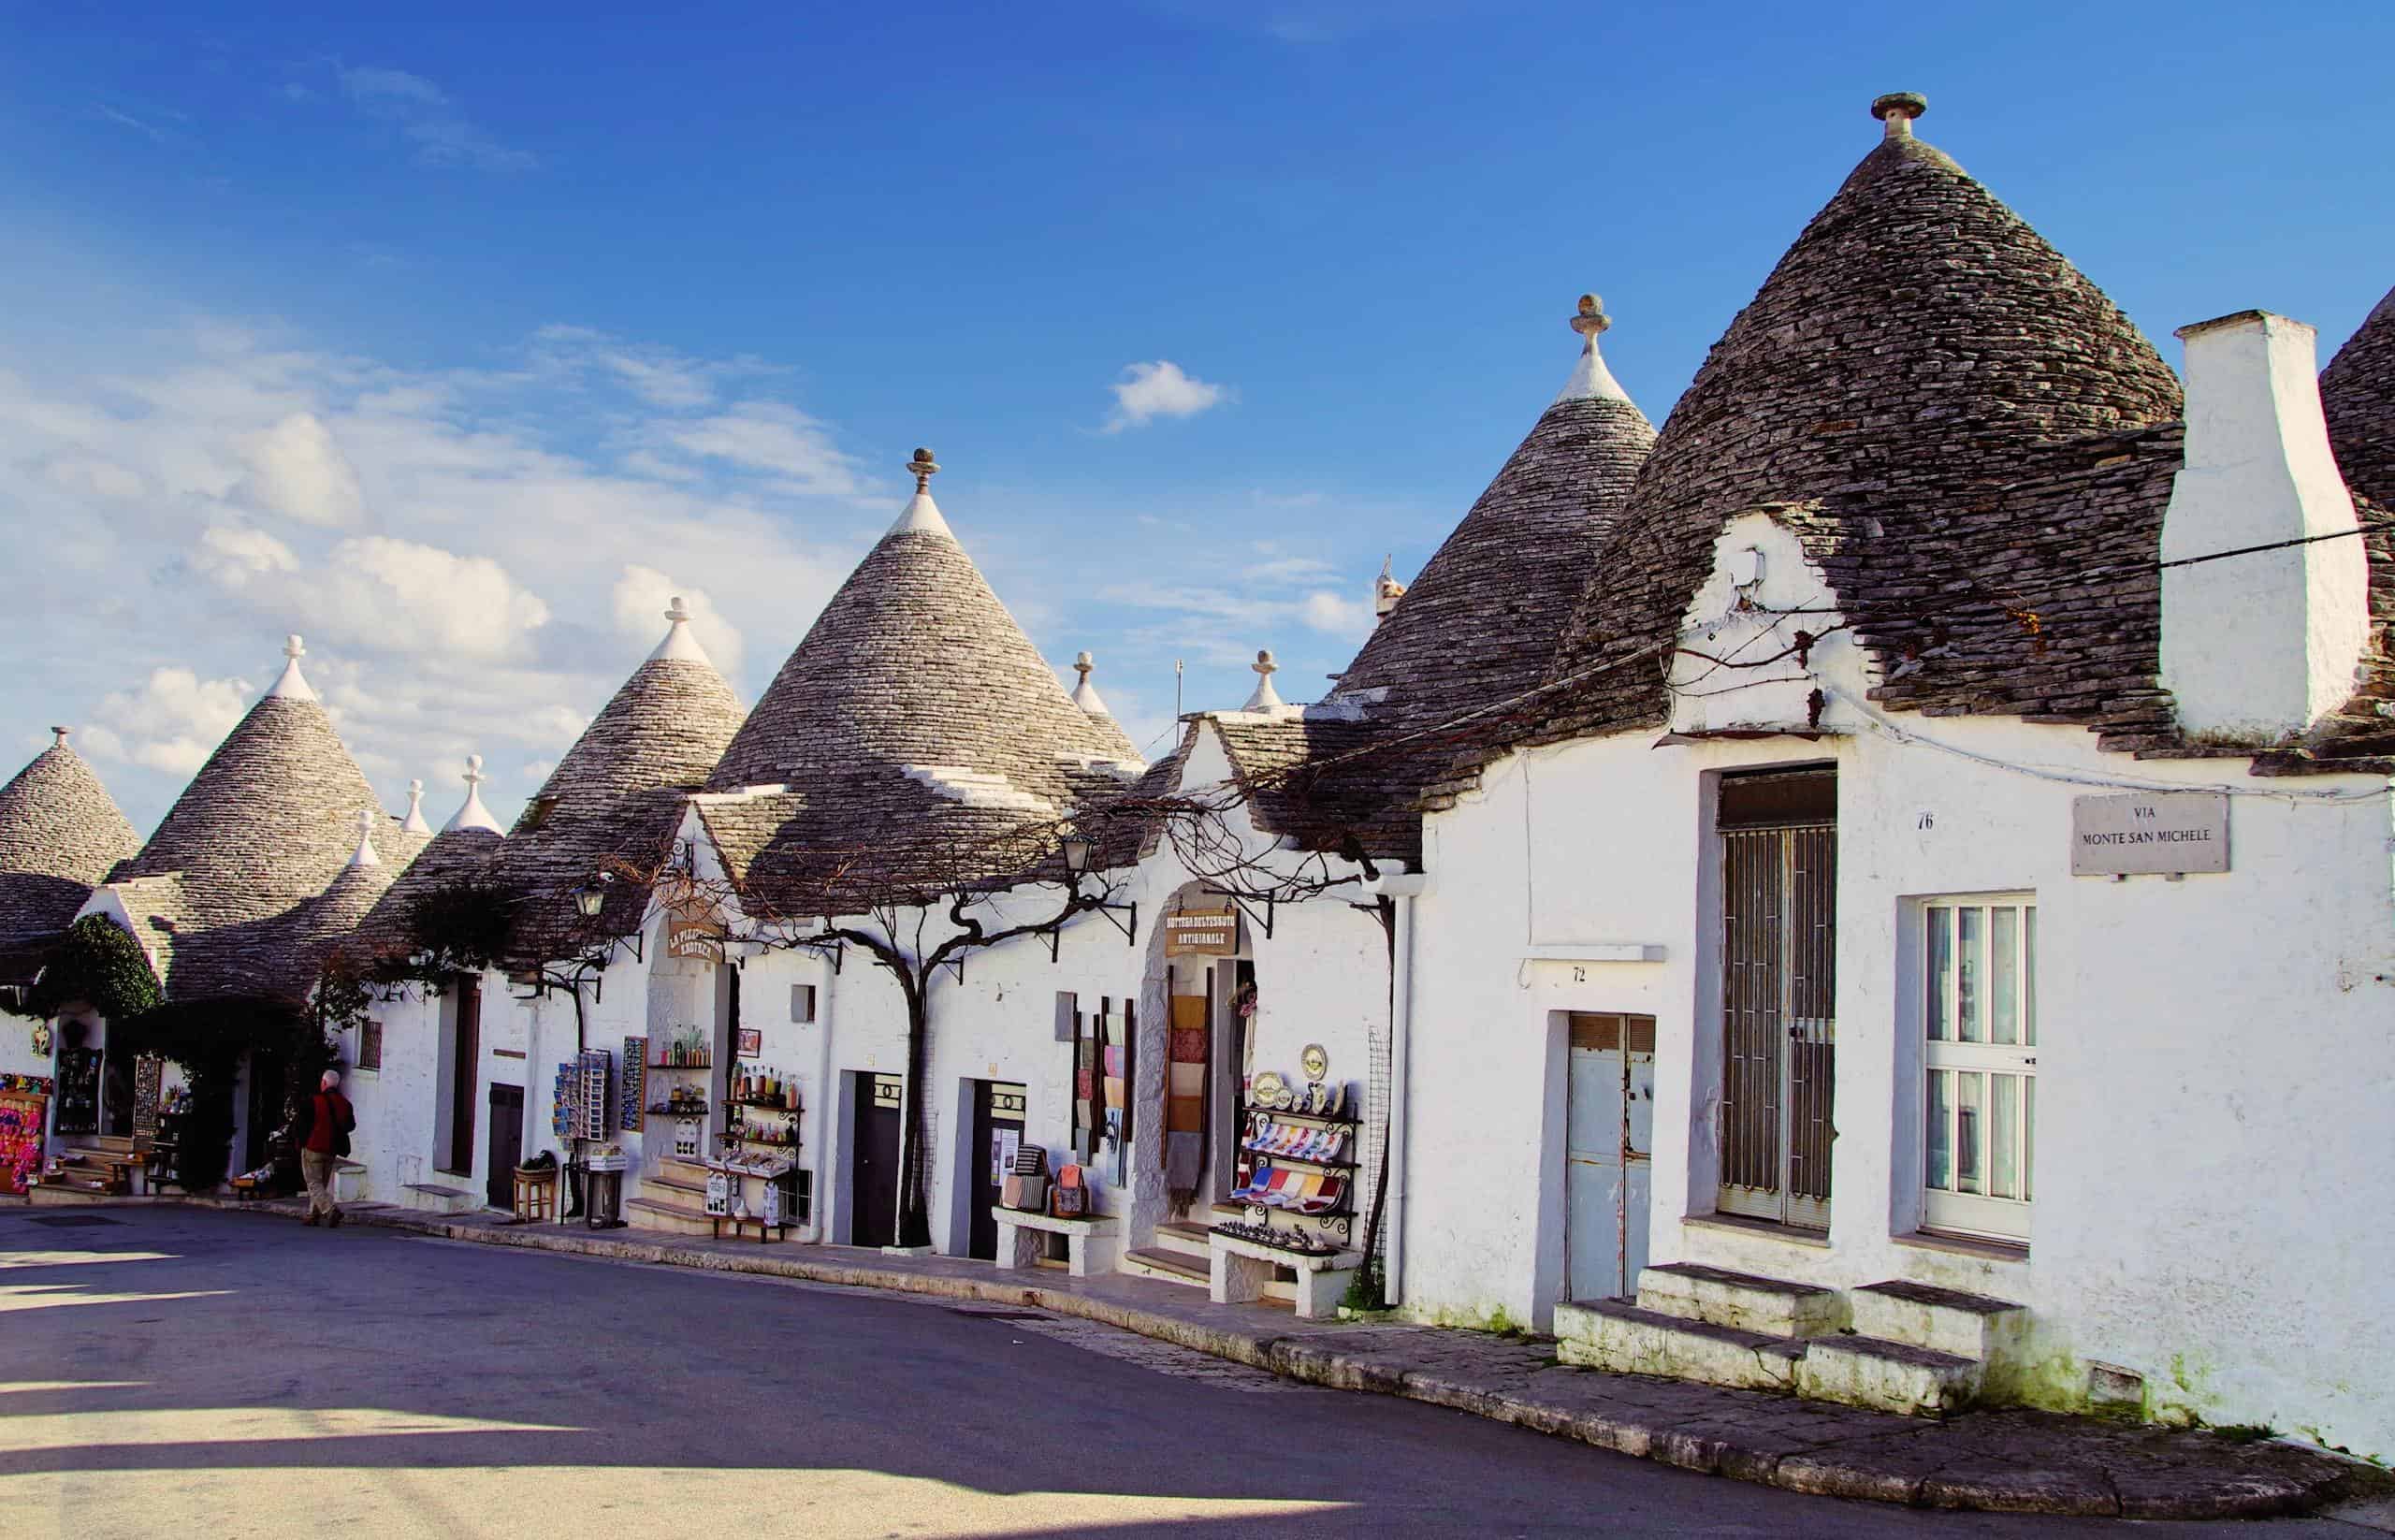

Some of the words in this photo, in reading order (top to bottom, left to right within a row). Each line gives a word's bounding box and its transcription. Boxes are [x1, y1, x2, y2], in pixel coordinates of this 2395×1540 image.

[2134, 807, 2156, 818] VIA
[1918, 812, 1933, 830] 76
[2083, 833, 2126, 845] MONTE
[2128, 832, 2154, 843] SAN
[2156, 829, 2212, 842] MICHELE
[669, 934, 680, 949] LA
[1178, 933, 1226, 944] ARTIGIANALE
[680, 941, 711, 958] ENOTECA
[1573, 966, 1586, 981] 72
